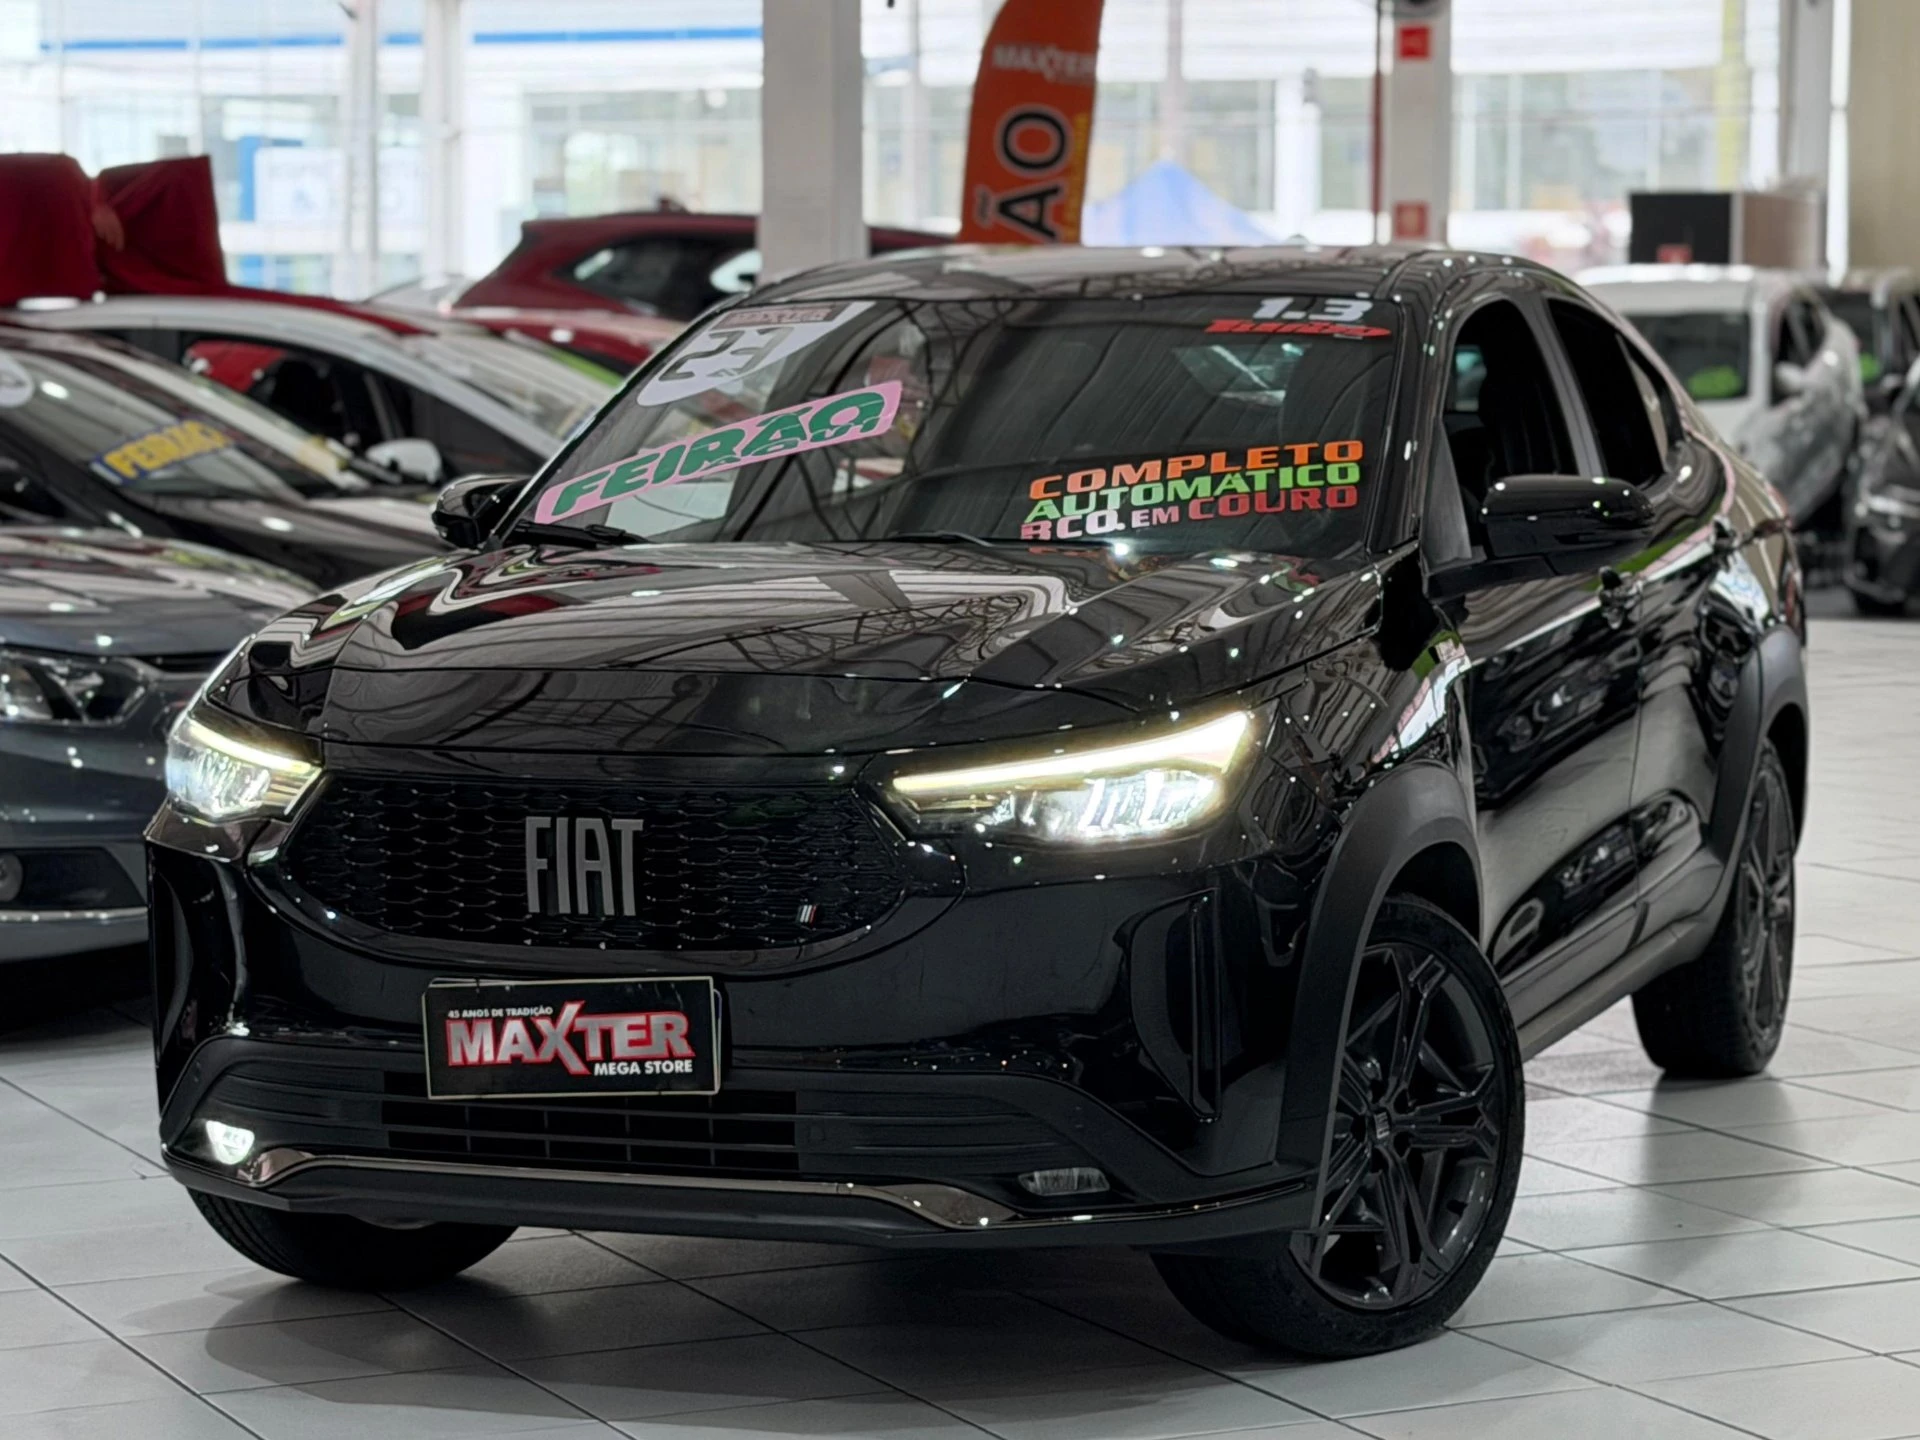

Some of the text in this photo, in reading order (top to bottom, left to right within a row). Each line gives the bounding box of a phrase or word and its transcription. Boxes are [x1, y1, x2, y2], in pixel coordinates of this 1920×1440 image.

[1253, 297, 1373, 322] 1.3
[552, 391, 885, 516] FEIRÃO
[1029, 440, 1363, 500] COMPLETO
[1131, 506, 1179, 529] EM
[1188, 485, 1358, 521] COURO
[525, 816, 644, 916] FIAT
[446, 1000, 696, 1075] MAXTER
[462, 1008, 489, 1018] ANOS
[491, 1008, 503, 1018] DE
[505, 1005, 553, 1017] TRADIÇÃO
[594, 1059, 693, 1076] MEGA STORE
